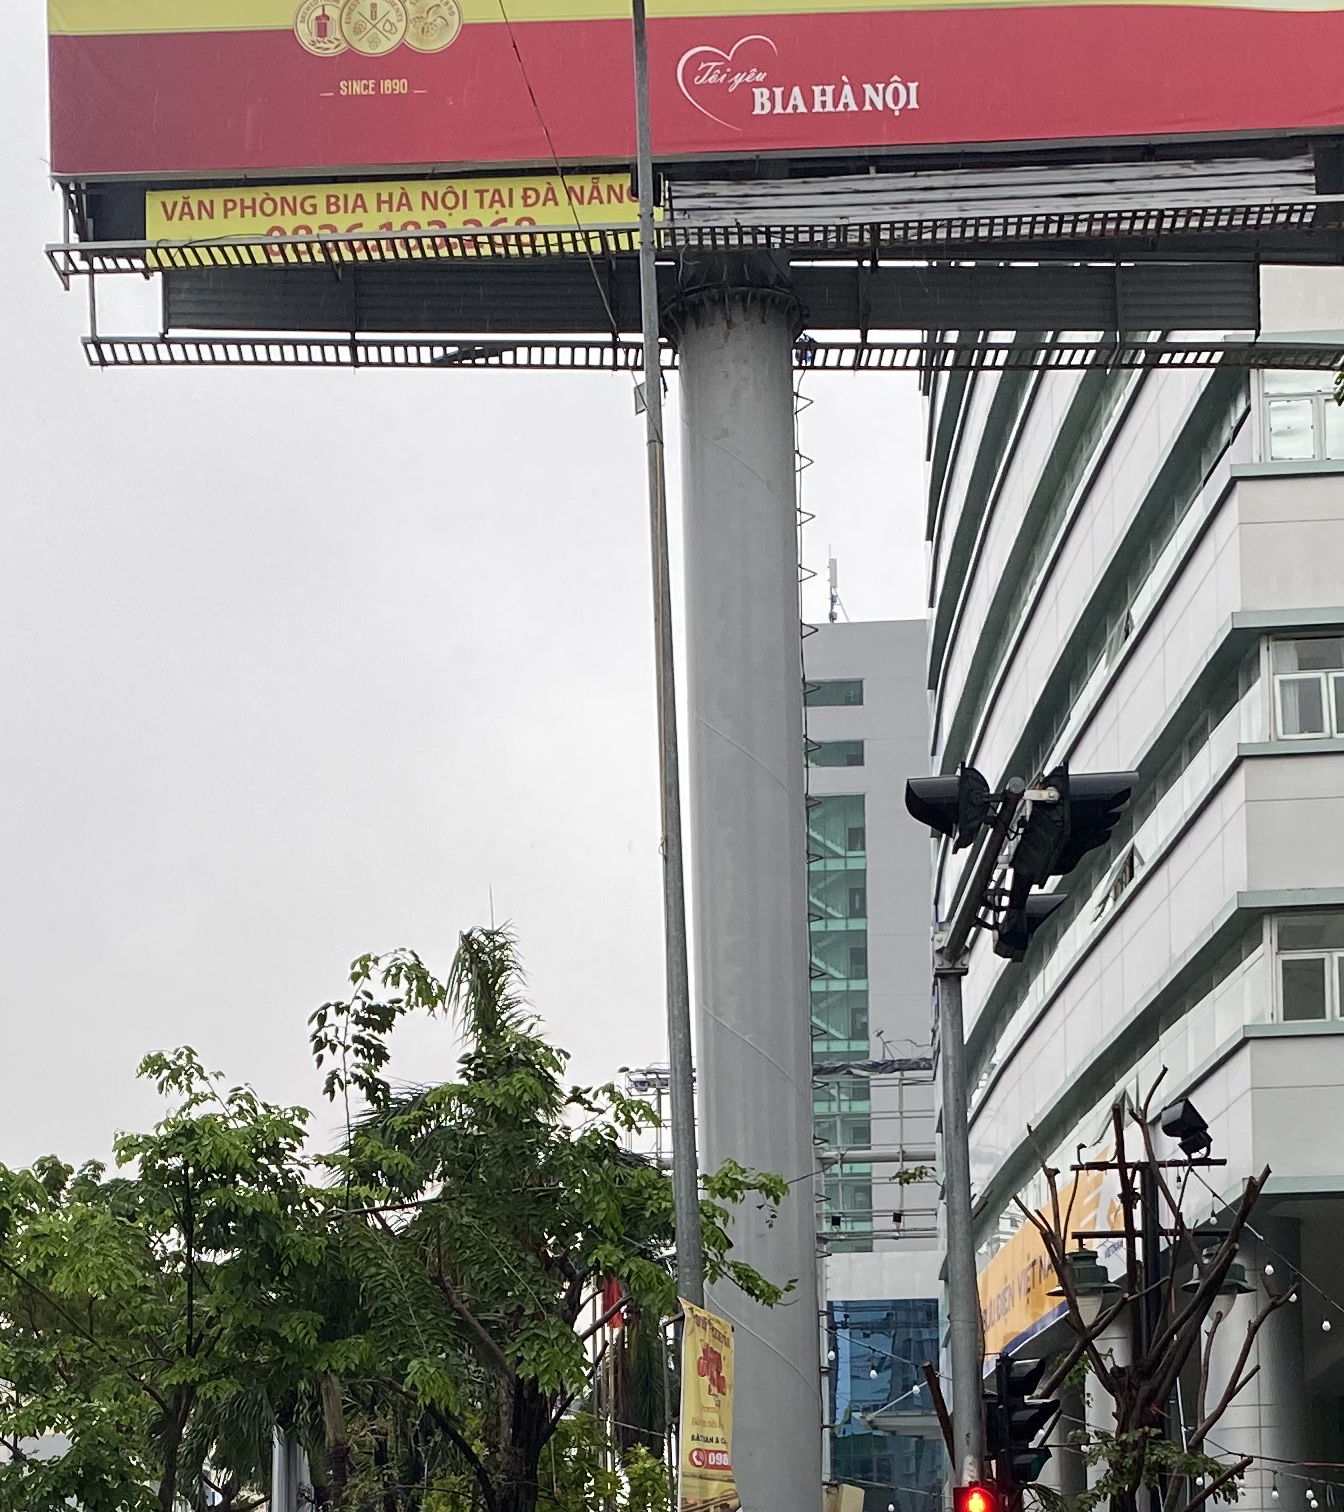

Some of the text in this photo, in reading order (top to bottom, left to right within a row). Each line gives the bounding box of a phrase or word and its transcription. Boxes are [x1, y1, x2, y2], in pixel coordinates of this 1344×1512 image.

[339, 79, 408, 96] SINCE 1890
[694, 61, 768, 92] Tôi yêu
[752, 75, 920, 117] BIA HÀ NỘI
[160, 195, 215, 222] VĂN
[223, 191, 318, 220] PHÒNG
[325, 193, 369, 215] BIA
[376, 186, 413, 213] HÀ
[421, 185, 468, 217] NỘI
[474, 187, 514, 215] TẠI
[521, 181, 560, 208] ĐÀ
